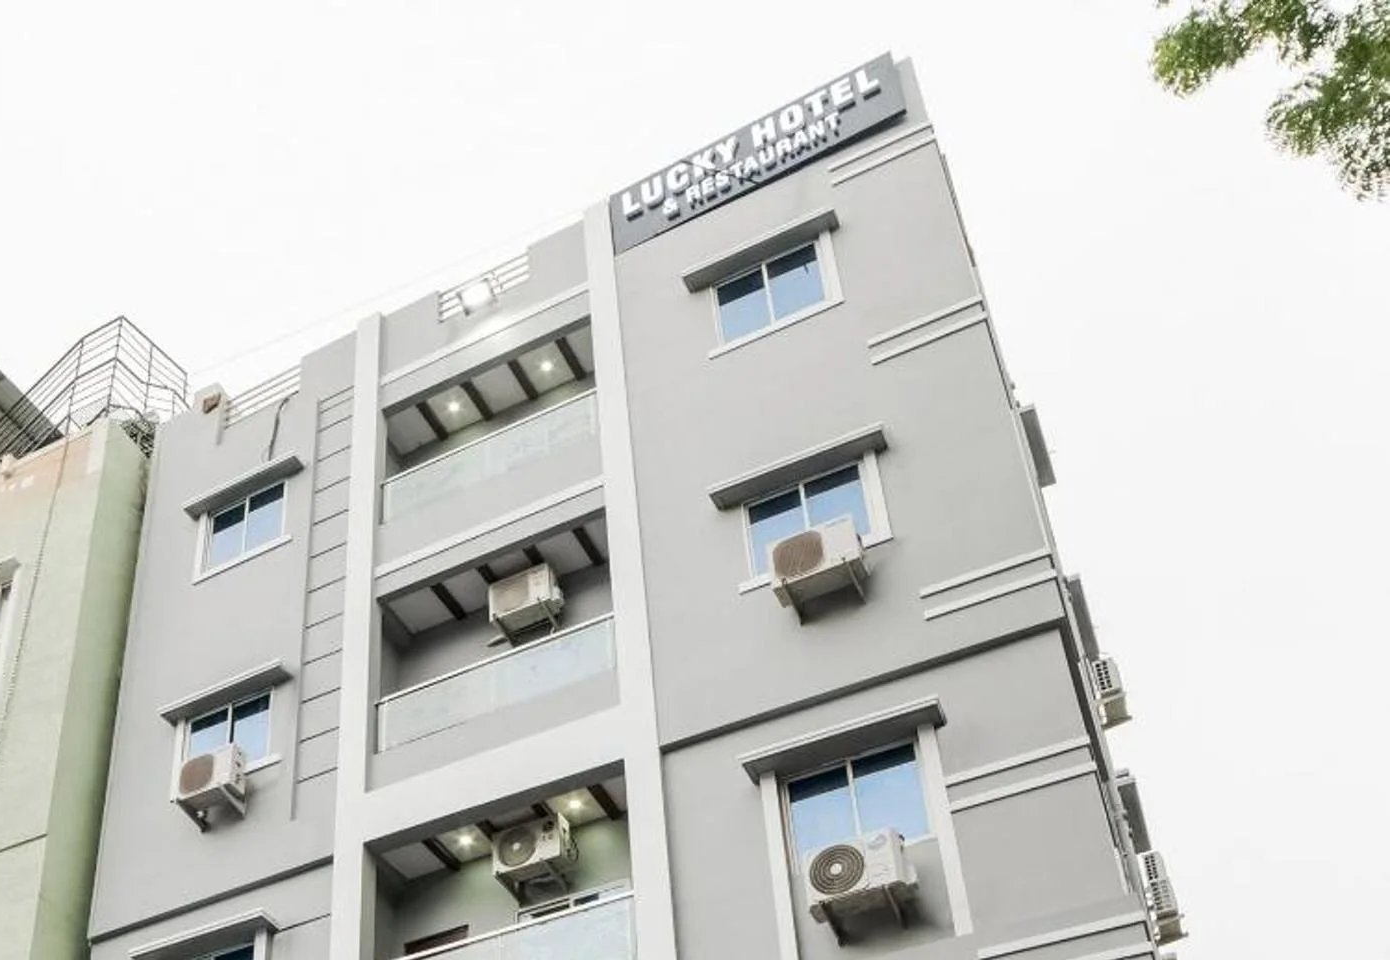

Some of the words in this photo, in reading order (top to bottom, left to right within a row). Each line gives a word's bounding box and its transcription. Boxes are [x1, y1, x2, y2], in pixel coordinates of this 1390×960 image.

[621, 136, 740, 218] LUCKY
[750, 69, 881, 148] HOTEL
[662, 198, 680, 218] &
[684, 111, 841, 206] RESTAURANT
